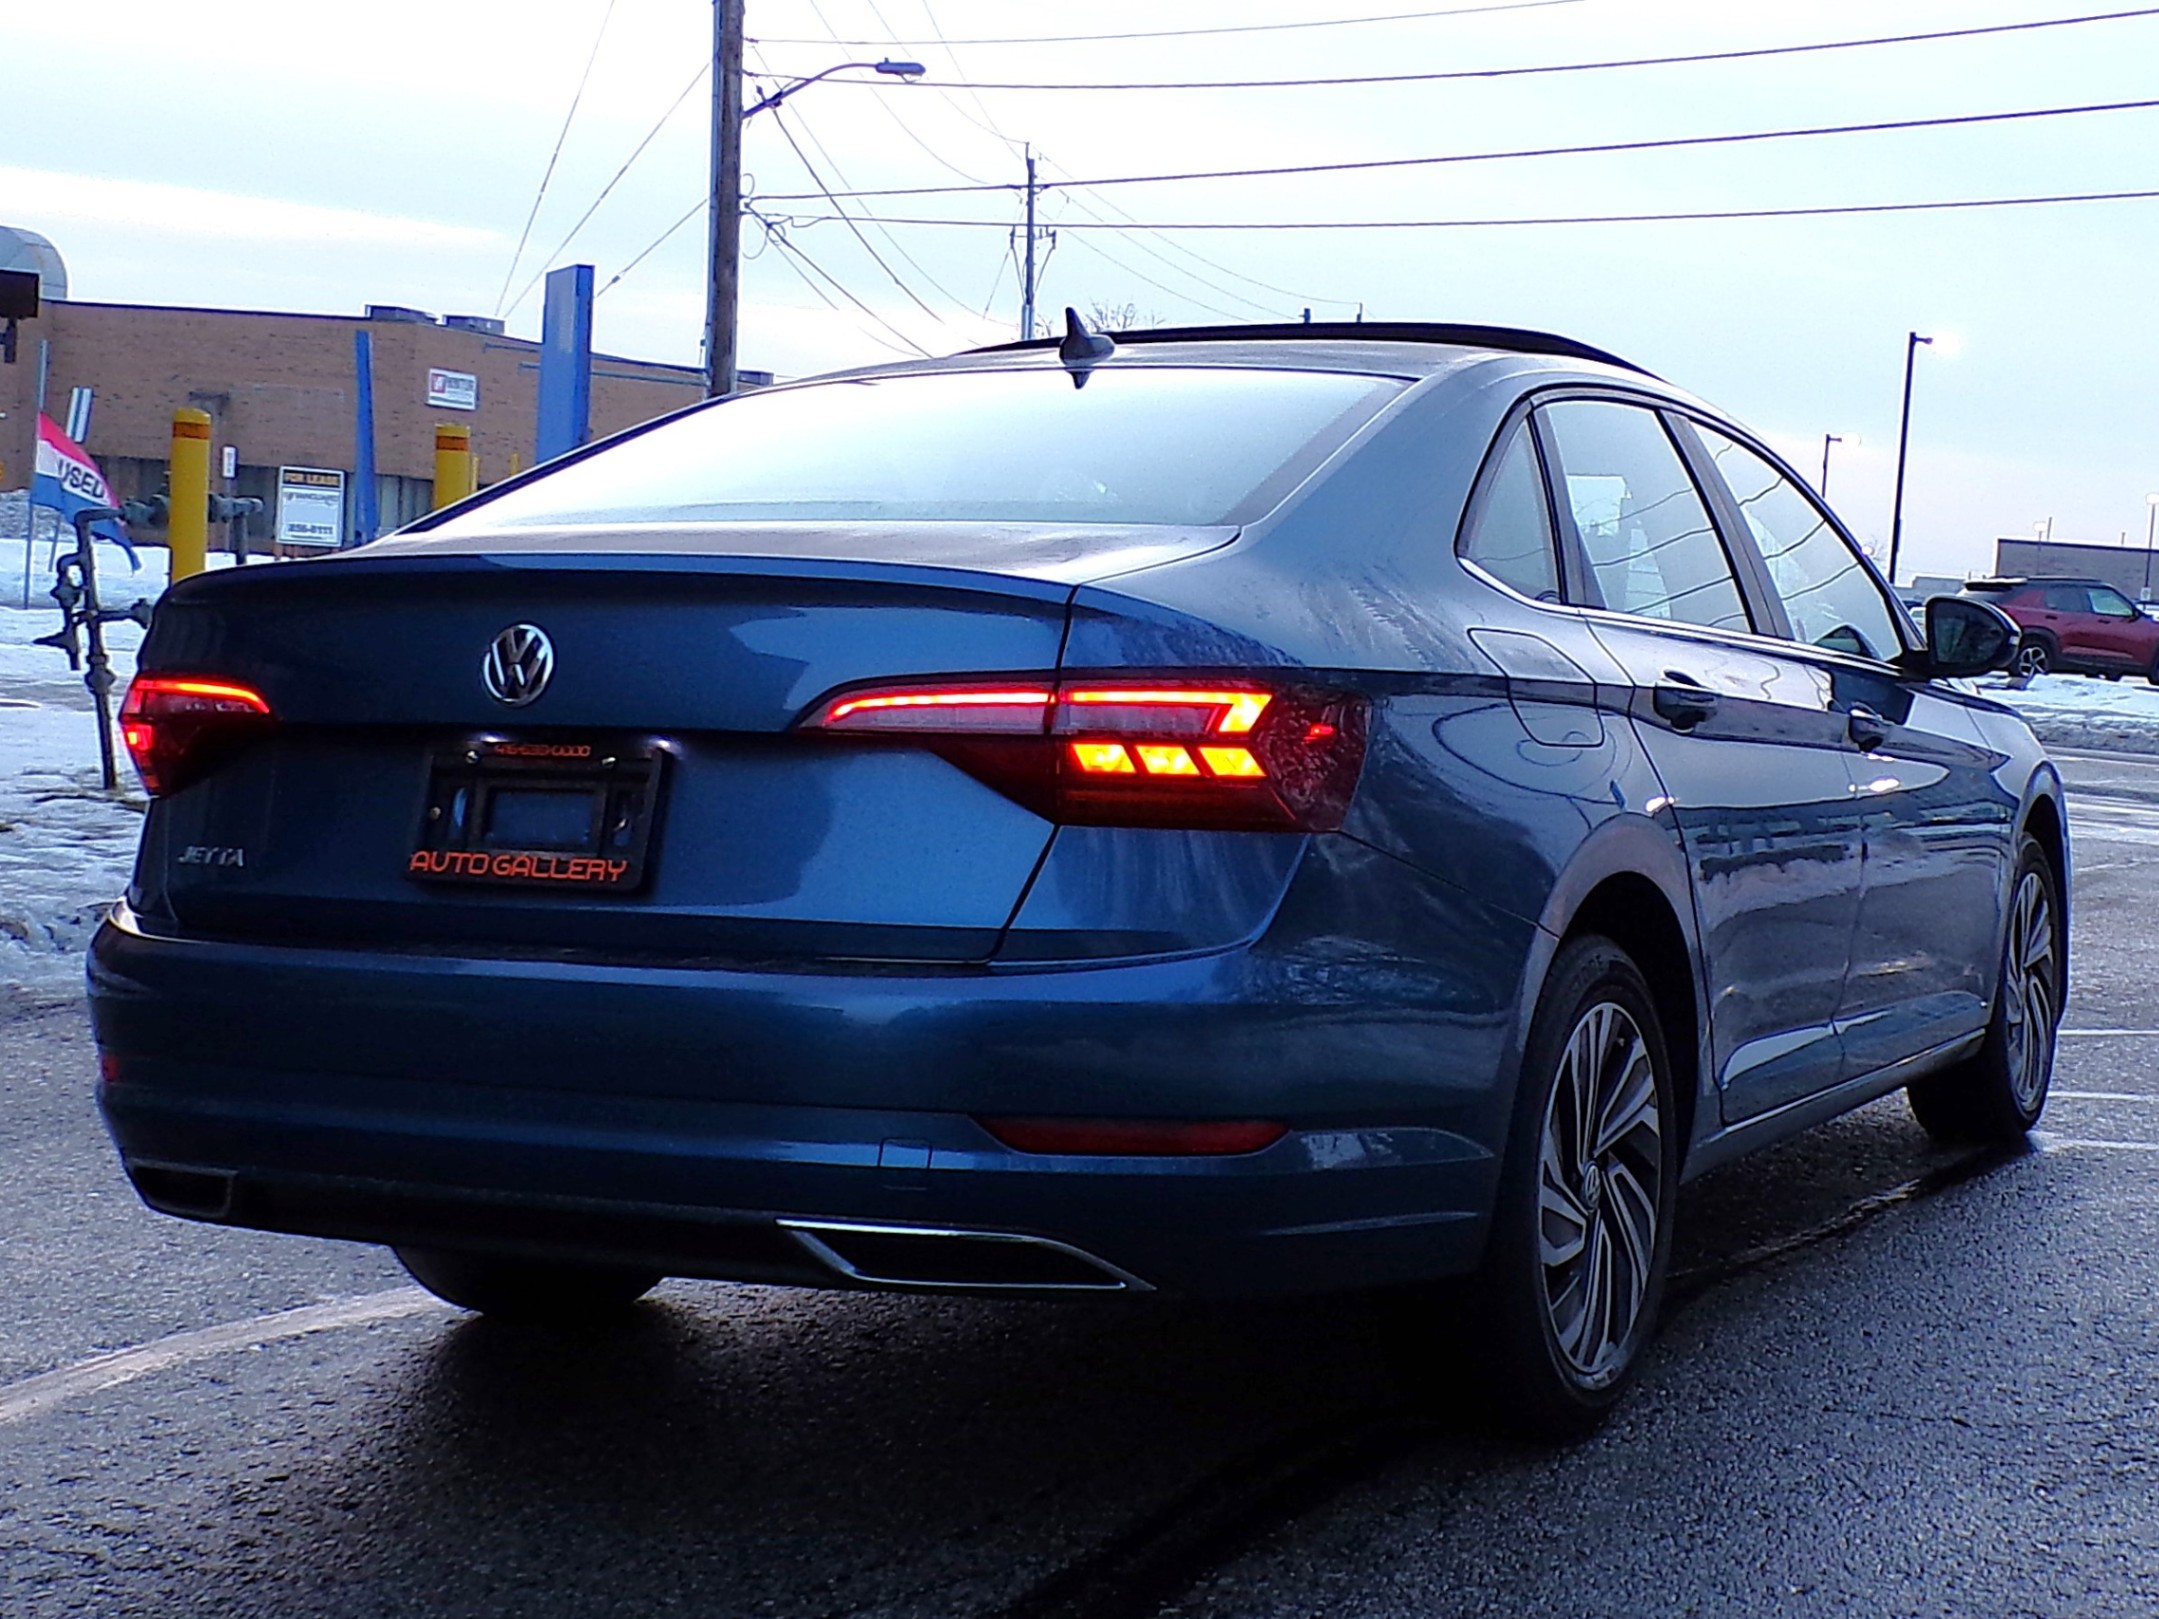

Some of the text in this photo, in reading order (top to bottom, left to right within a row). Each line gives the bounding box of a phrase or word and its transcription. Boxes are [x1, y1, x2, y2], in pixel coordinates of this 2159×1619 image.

[58, 459, 105, 499] USED
[284, 472, 339, 486] FOR LEASE
[178, 846, 244, 867] JETTA
